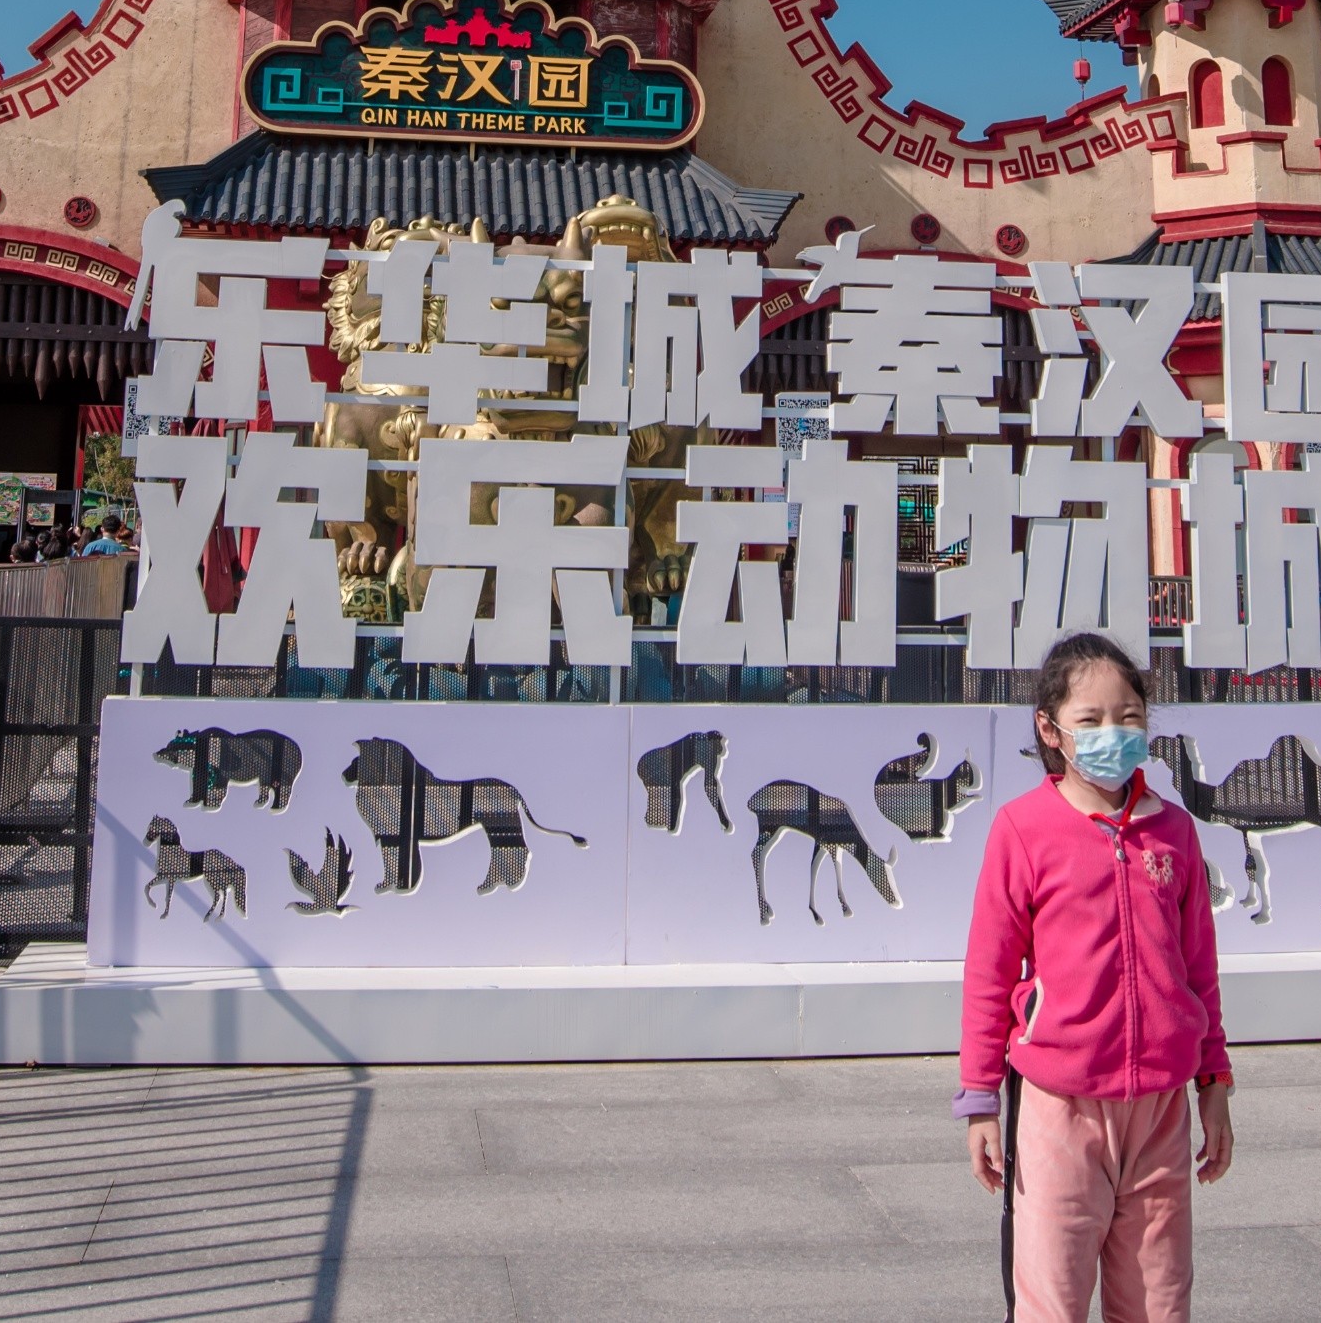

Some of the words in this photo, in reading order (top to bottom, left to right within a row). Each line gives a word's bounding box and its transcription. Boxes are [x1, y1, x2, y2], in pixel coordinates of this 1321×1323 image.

[359, 45, 594, 108] 秦汉园
[360, 107, 398, 126] QIN
[407, 109, 448, 129] HAN
[457, 112, 526, 132] THEME
[534, 115, 586, 134] PARK
